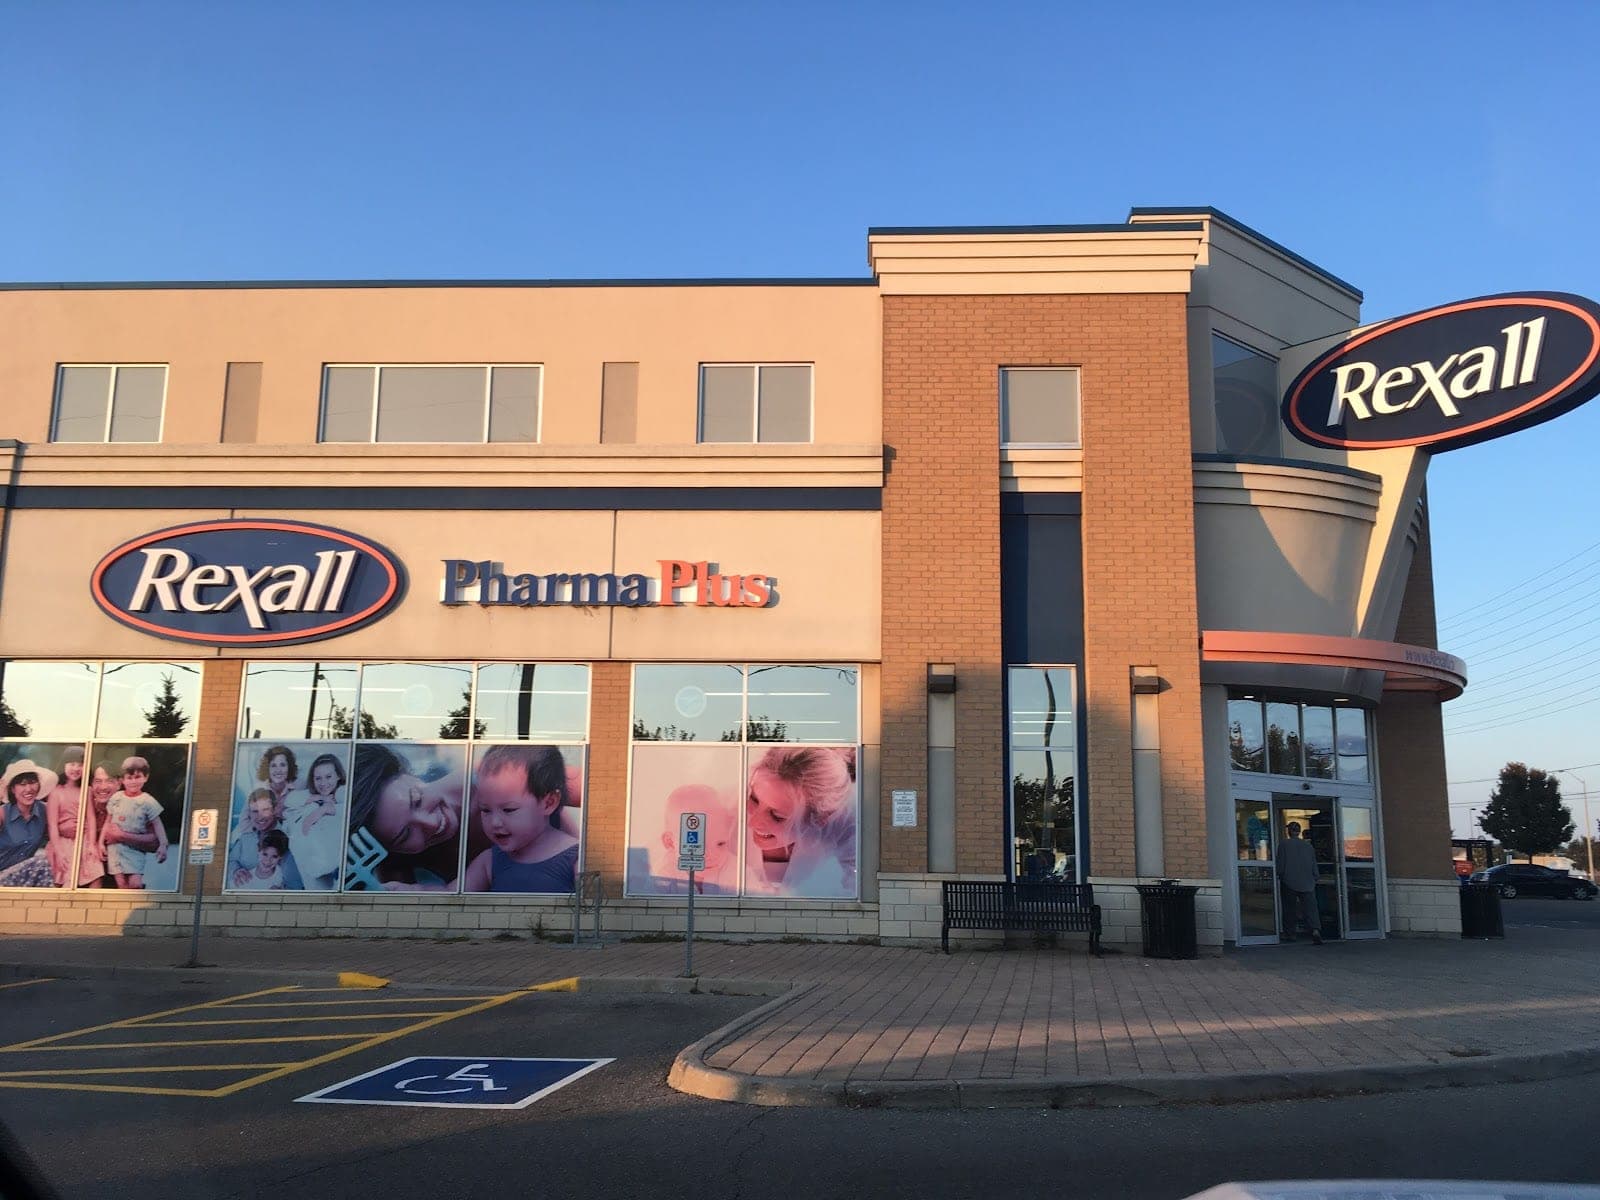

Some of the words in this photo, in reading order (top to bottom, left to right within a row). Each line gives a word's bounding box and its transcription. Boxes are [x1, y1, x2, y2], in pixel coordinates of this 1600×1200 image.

[1326, 316, 1547, 427] Rexall
[128, 548, 357, 629] Rexall
[440, 560, 651, 607] Pharma
[656, 560, 773, 608] Plus
